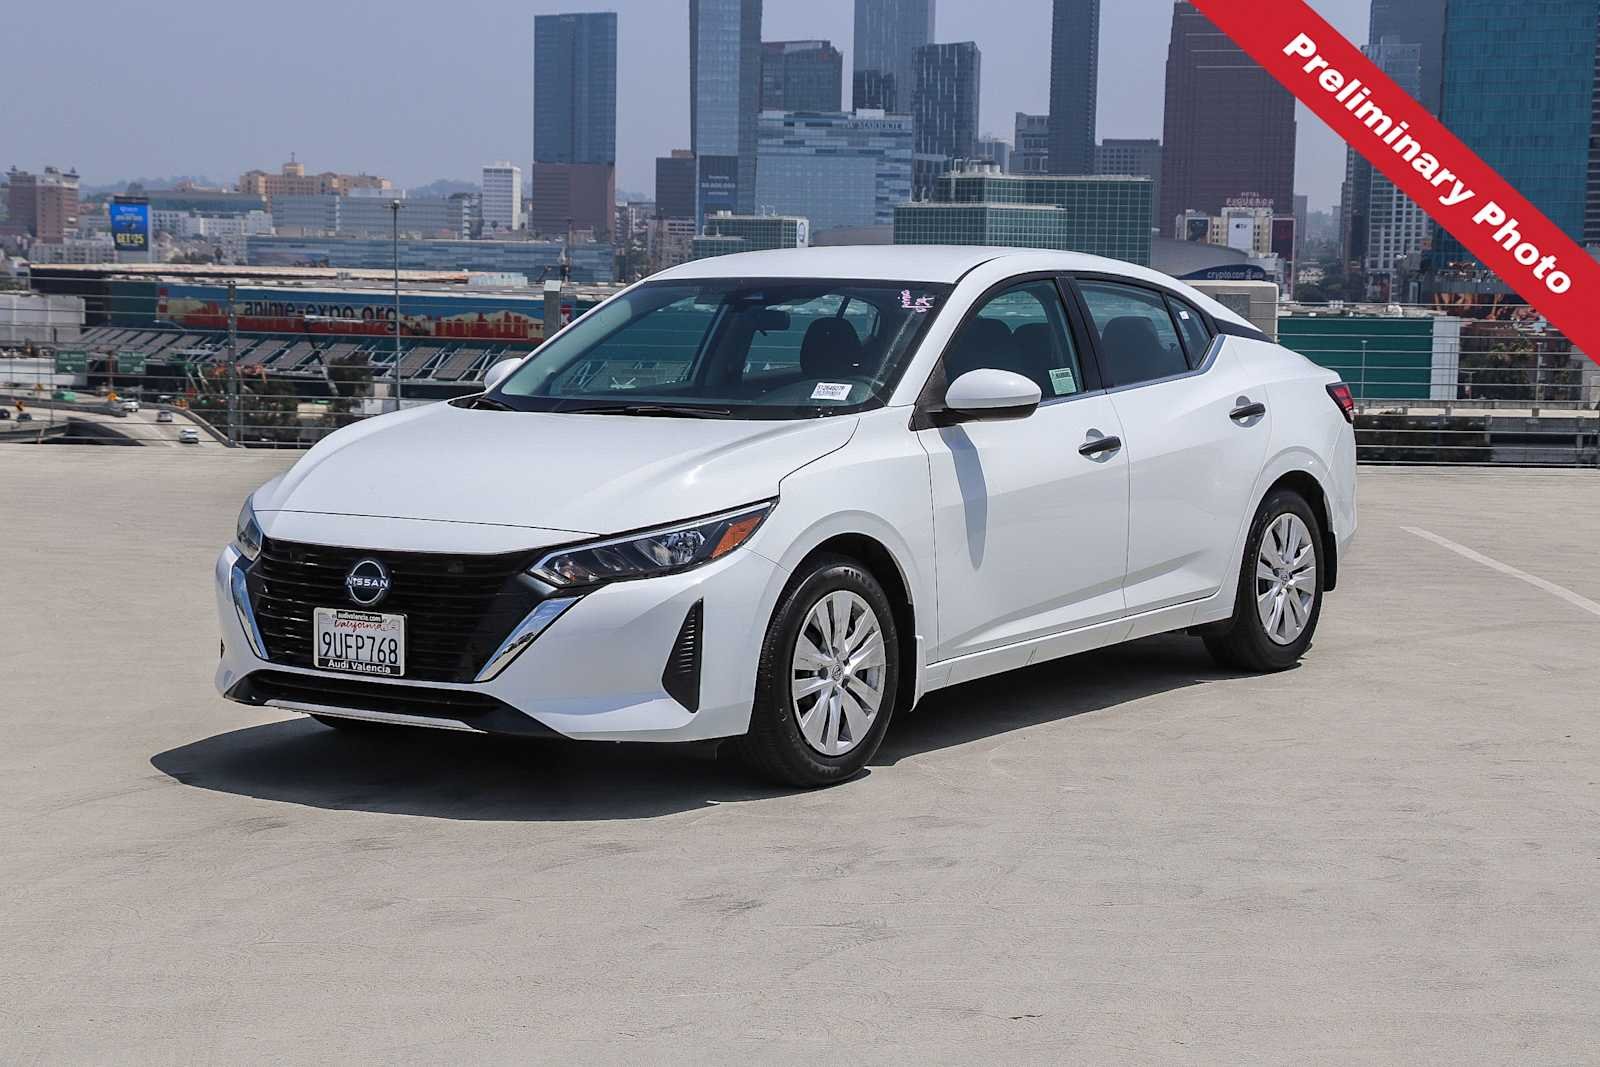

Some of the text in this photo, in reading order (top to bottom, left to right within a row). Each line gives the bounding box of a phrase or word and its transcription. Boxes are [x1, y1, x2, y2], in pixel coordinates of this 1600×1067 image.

[244, 295, 397, 332] anime-expoorg
[346, 577, 389, 588] NISSAN
[335, 620, 382, 632] California
[322, 631, 398, 665] 9UFP768
[328, 659, 391, 674] Audi Valencia
